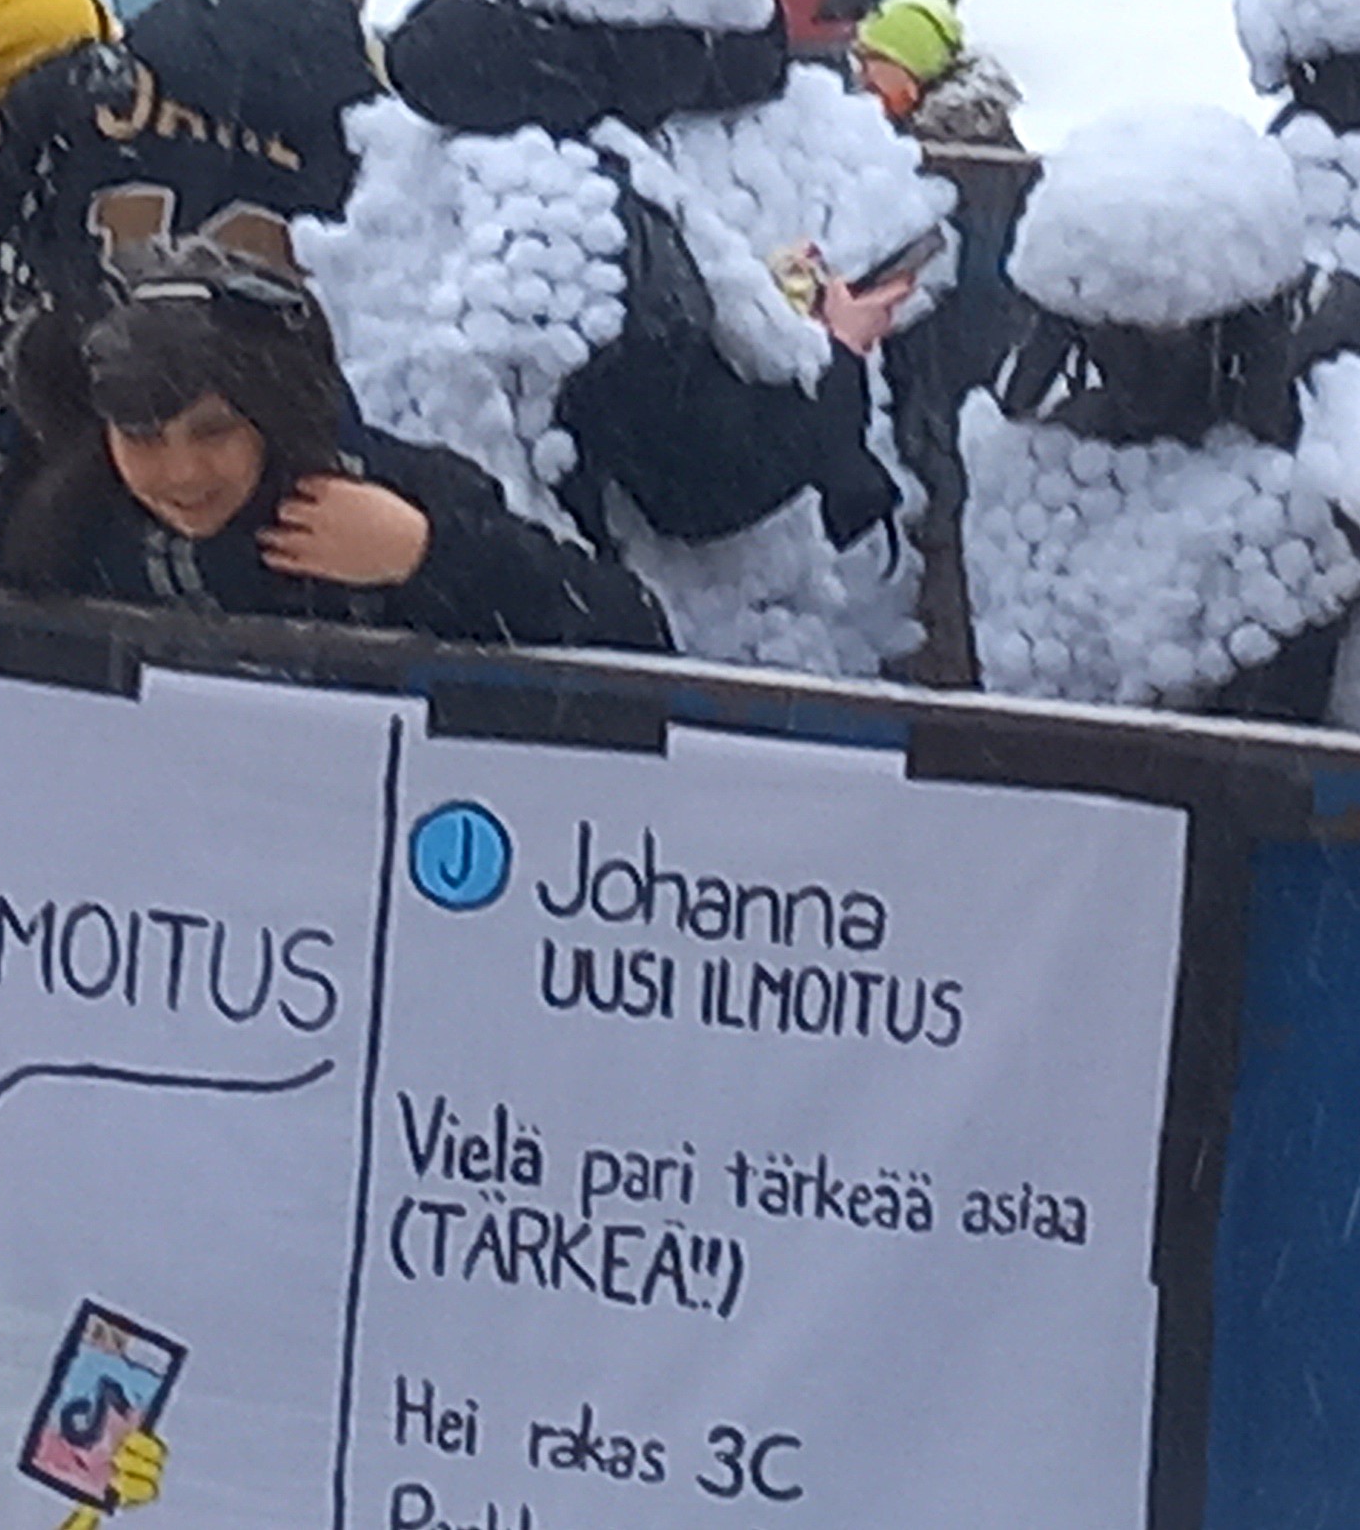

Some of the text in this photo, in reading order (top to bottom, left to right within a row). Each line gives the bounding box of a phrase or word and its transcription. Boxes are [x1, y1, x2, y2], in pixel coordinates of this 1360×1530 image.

[439, 814, 476, 889] J
[535, 819, 890, 952] Johanna
[540, 937, 964, 1048] UUSI ILMOITUS
[396, 1090, 1088, 1247] Vielä pari tärkeää asiaa
[394, 1374, 804, 1503] Hei rakas 3C
